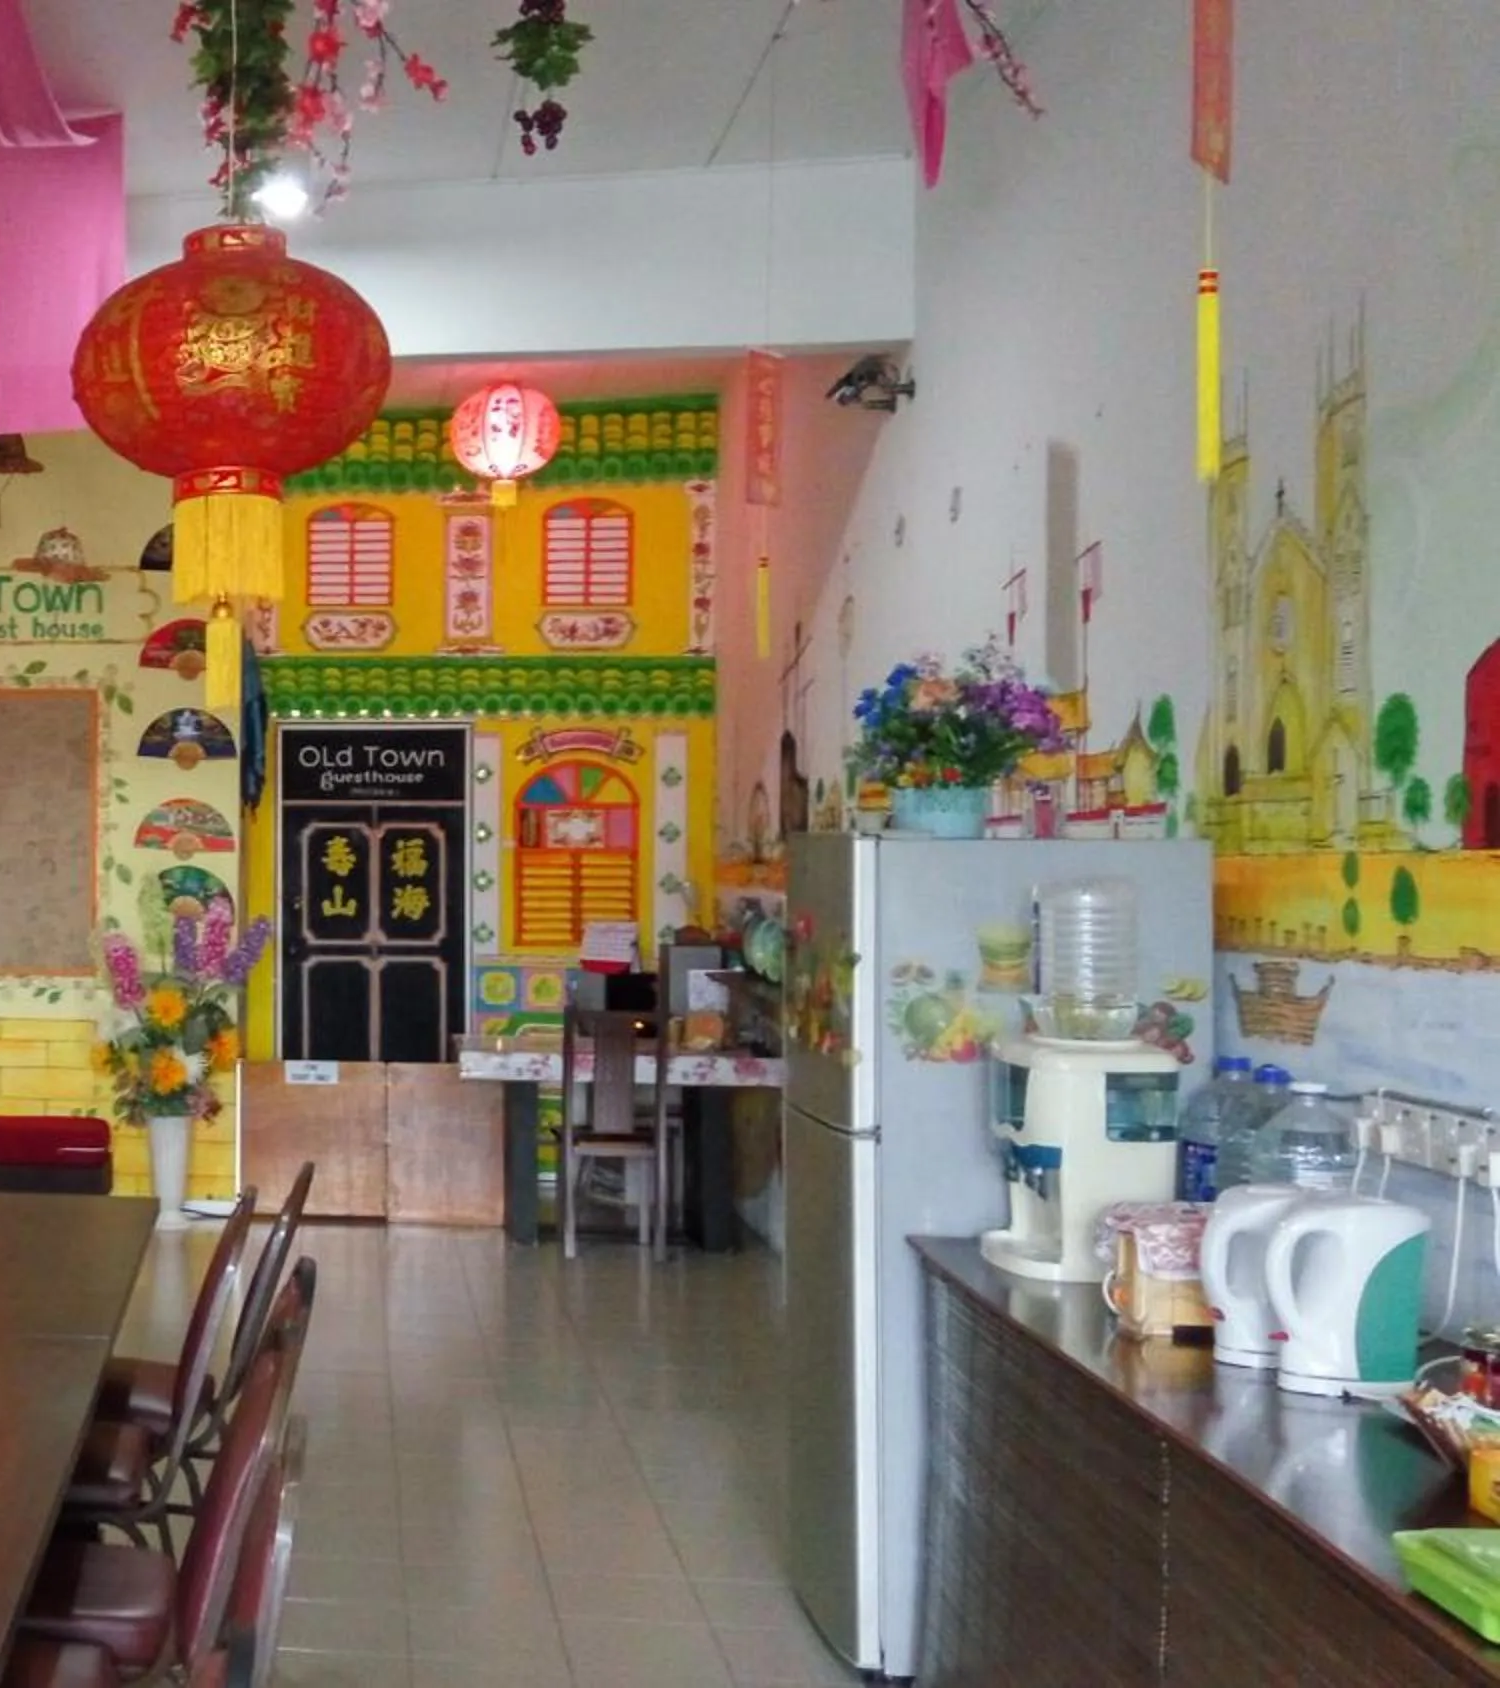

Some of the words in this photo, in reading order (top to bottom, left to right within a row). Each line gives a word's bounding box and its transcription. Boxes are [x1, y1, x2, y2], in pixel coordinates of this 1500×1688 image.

[32, 616, 104, 639] house
[363, 745, 446, 767] Town
[319, 770, 425, 791] guesthouse
